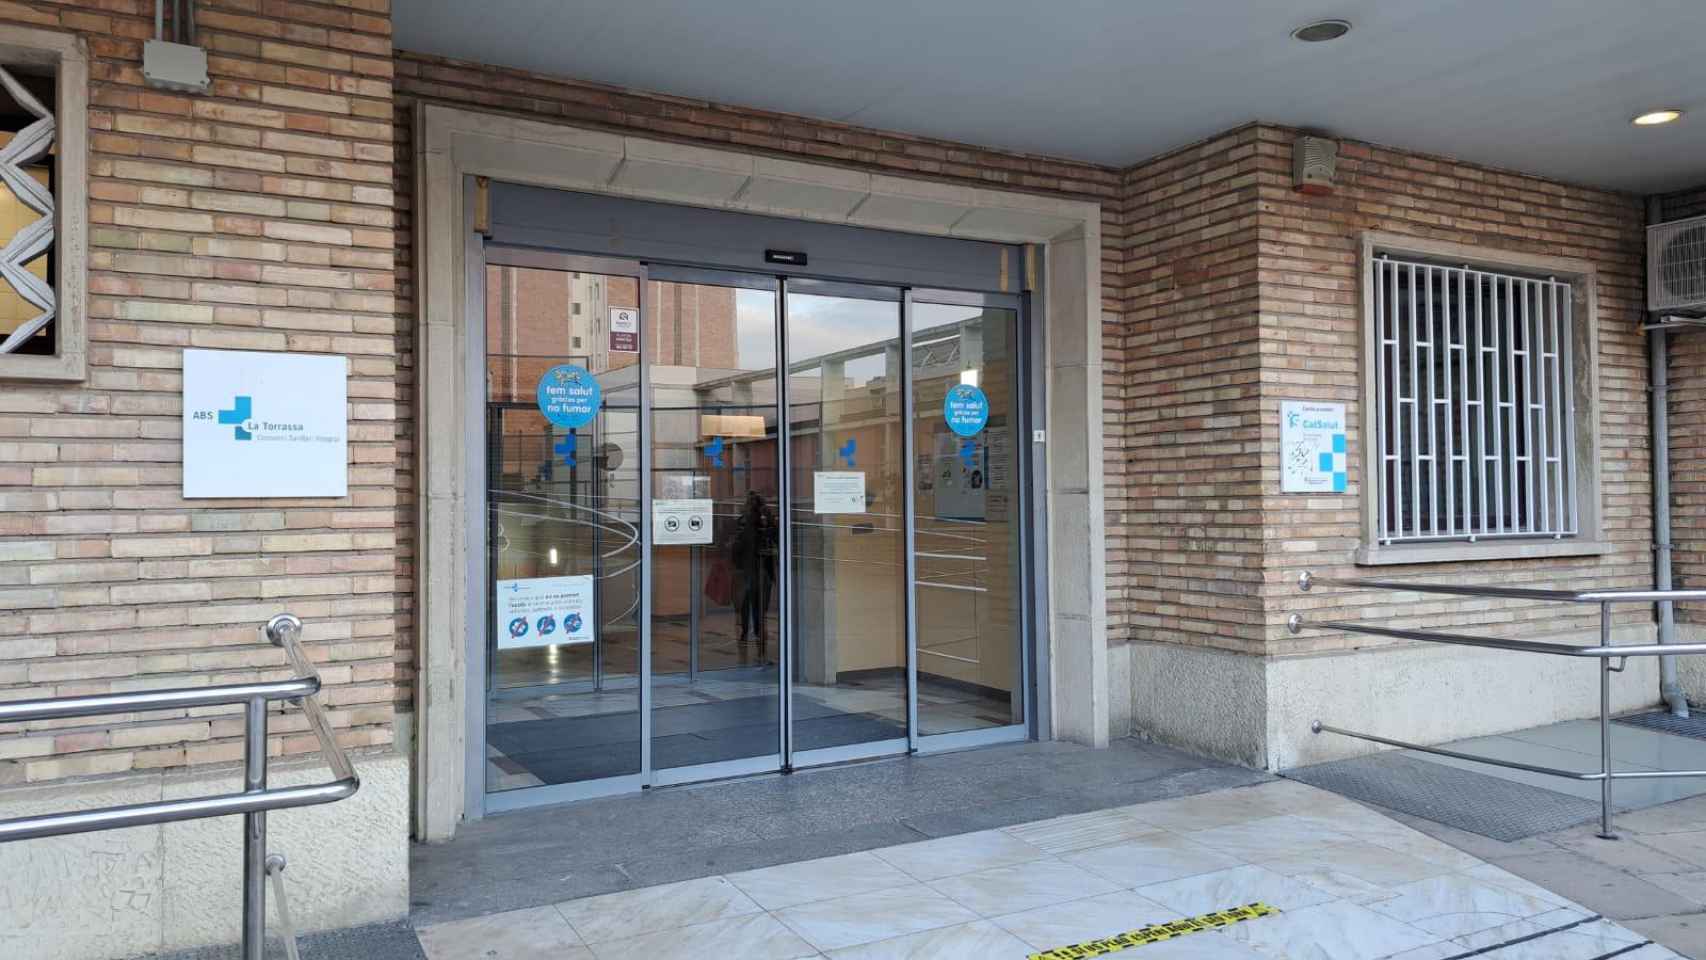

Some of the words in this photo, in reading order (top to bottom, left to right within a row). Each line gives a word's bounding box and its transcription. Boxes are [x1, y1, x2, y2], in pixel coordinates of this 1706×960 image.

[546, 385, 566, 395] fem
[569, 385, 593, 396] salut
[547, 404, 560, 412] no
[562, 403, 592, 414] fumar
[193, 411, 214, 420] ABS
[248, 422, 259, 431] La
[263, 422, 304, 431] Torrassa
[1303, 420, 1338, 429] CatSalut
